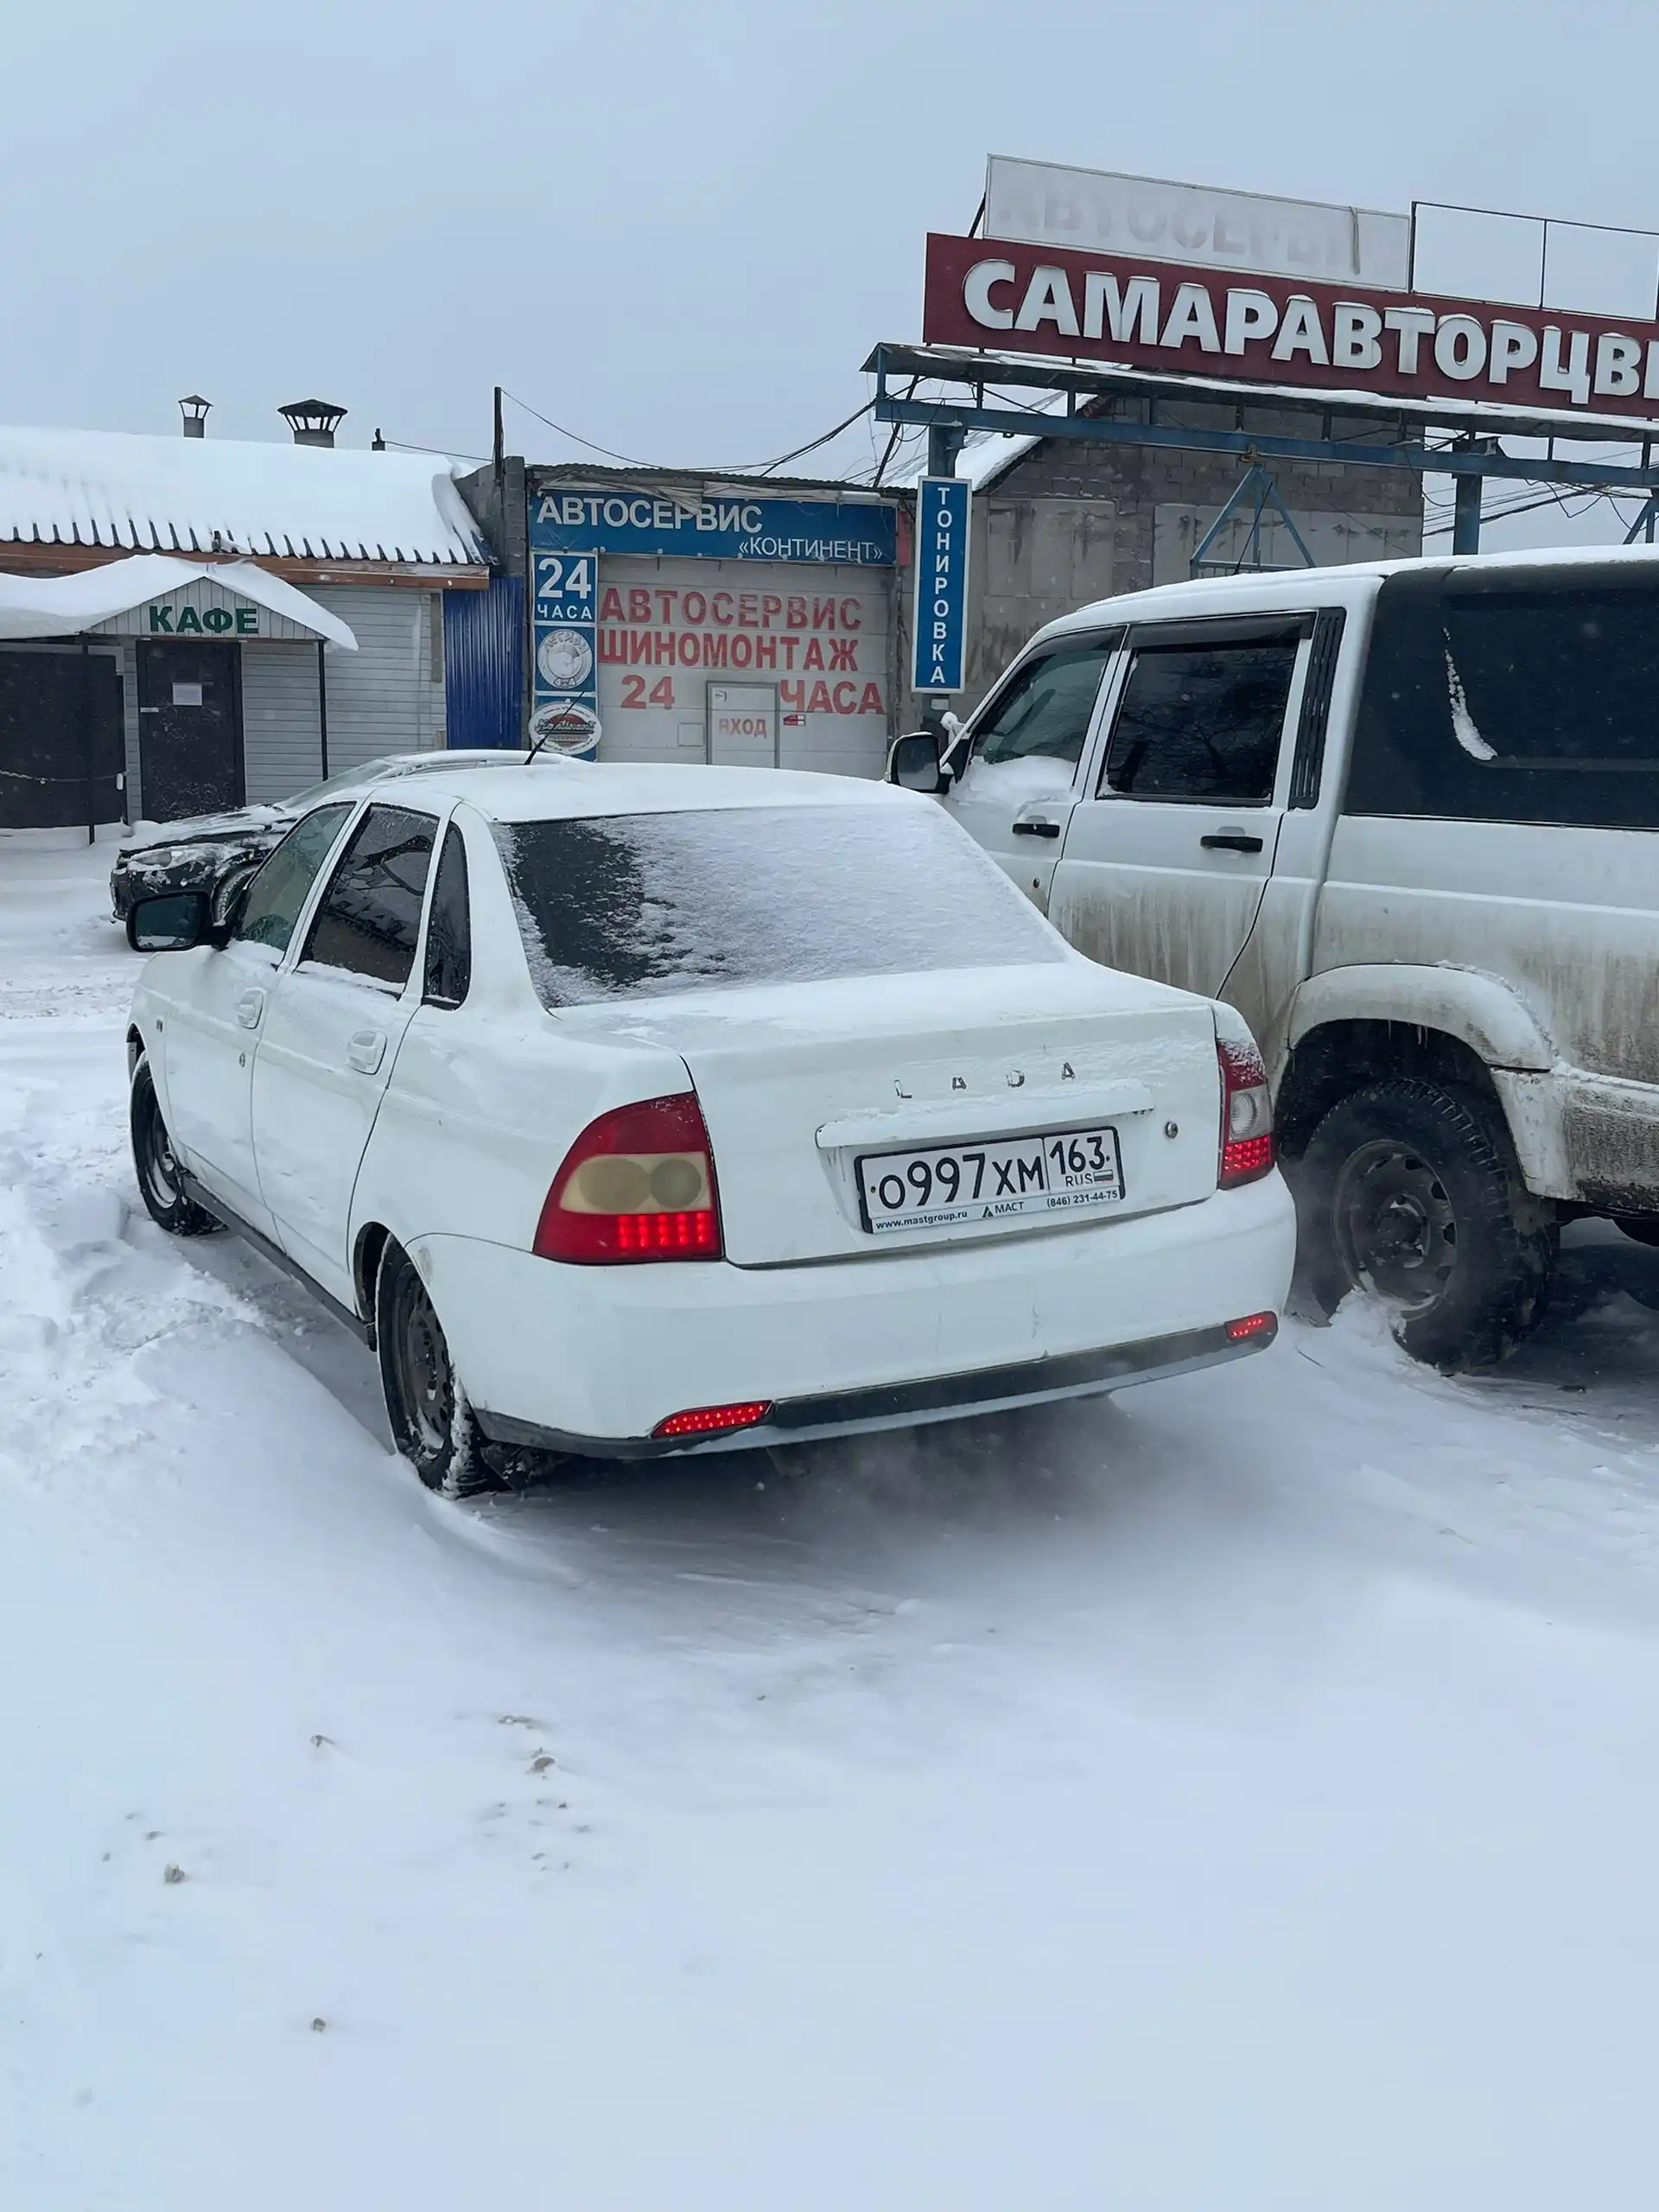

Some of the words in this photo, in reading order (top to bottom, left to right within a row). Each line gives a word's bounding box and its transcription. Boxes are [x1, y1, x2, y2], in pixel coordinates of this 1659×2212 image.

[537, 496, 763, 533] АВТОСЕРВИС
[739, 537, 883, 560] «КОНТИНЕНТ»
[538, 558, 592, 599] 24
[931, 487, 952, 683] ТОНИРОВКА
[149, 606, 259, 633] КАФЕ
[537, 604, 593, 620] ЧАСА
[600, 588, 861, 631] АВТОСЕРВИС
[598, 629, 858, 671] ШИНОМОНТАЖ
[621, 675, 675, 710] 24
[779, 679, 885, 715] ЧАСА
[719, 718, 767, 739] ВХОД
[894, 1063, 1075, 1099] LADA
[1050, 1136, 1105, 1175] 163
[1065, 1173, 1093, 1187] RUS
[1047, 1196, 1071, 1208] (846)
[1073, 1190, 1118, 1204] 231-44-75
[876, 1211, 968, 1230] www.mastgroup.ru
